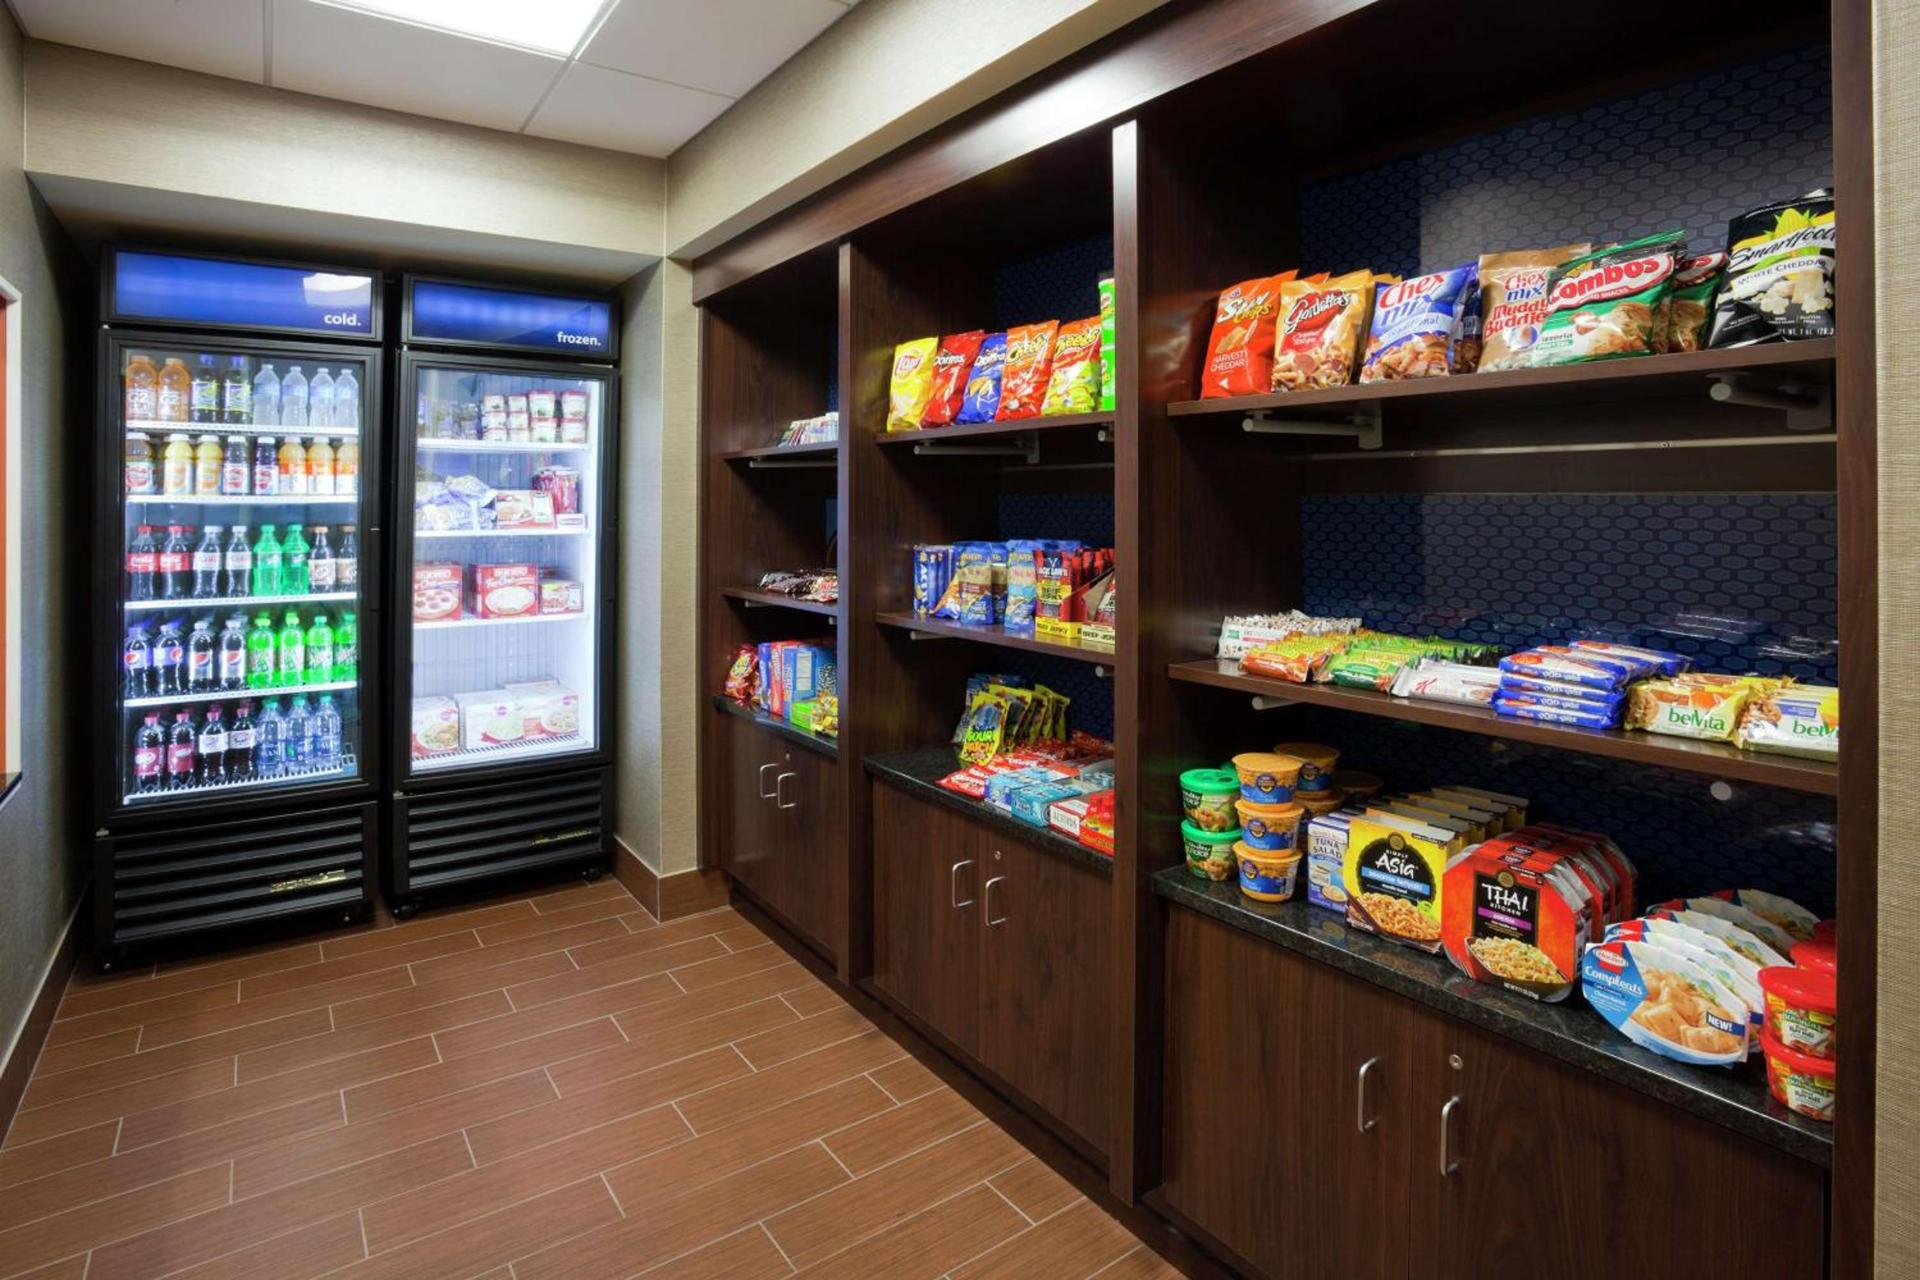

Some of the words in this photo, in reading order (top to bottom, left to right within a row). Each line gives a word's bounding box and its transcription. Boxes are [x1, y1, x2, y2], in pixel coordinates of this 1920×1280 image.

[1504, 270, 1546, 290] Chex
[1738, 269, 1773, 285] WHITE
[1380, 274, 1444, 309] Chex
[324, 313, 361, 327] cold.
[557, 331, 601, 346] frozen.
[1668, 708, 1725, 731] belVita
[1313, 845, 1342, 860] SALAD
[1481, 883, 1528, 911] THAI
[1584, 965, 1642, 995] Compleats
[1708, 1015, 1733, 1032] NEW!
